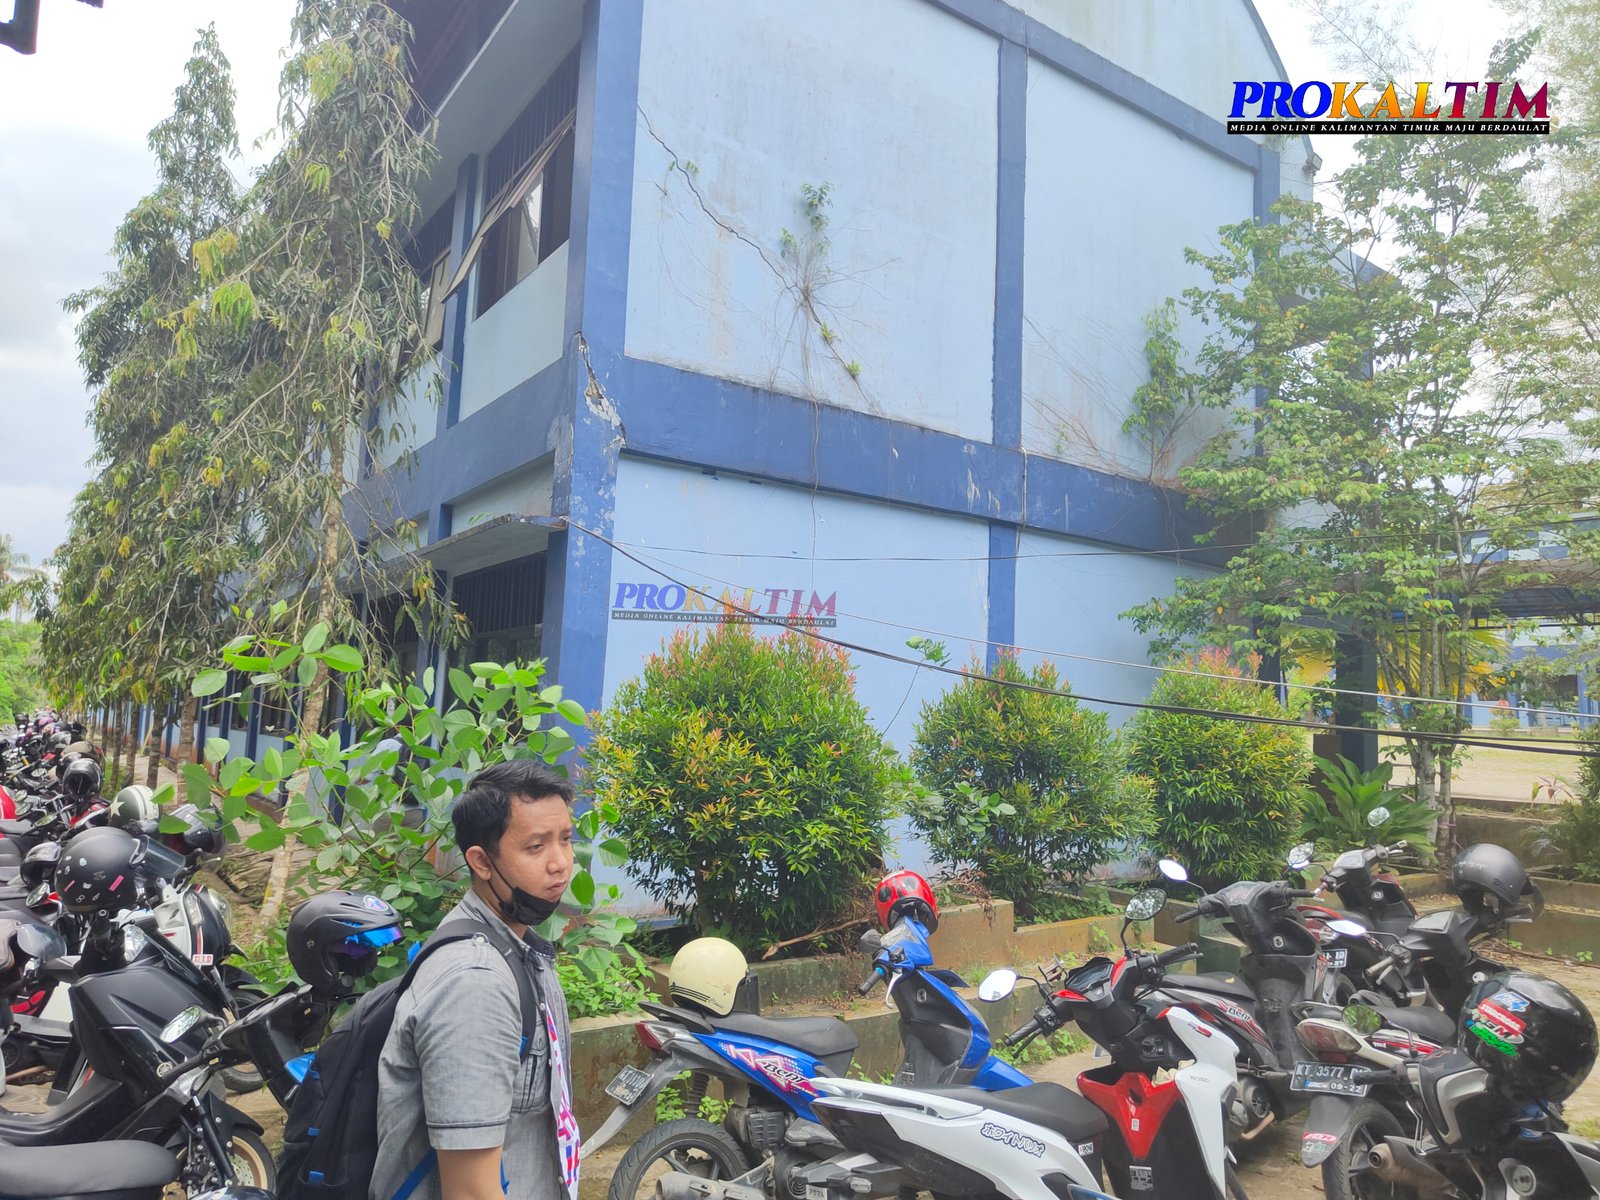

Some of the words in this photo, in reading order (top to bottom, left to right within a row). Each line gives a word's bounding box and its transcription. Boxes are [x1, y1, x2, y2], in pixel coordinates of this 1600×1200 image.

[1296, 1064, 1312, 1076] KT
[1316, 1066, 1345, 1079] 3577
[1330, 1082, 1362, 1093] 09-22
